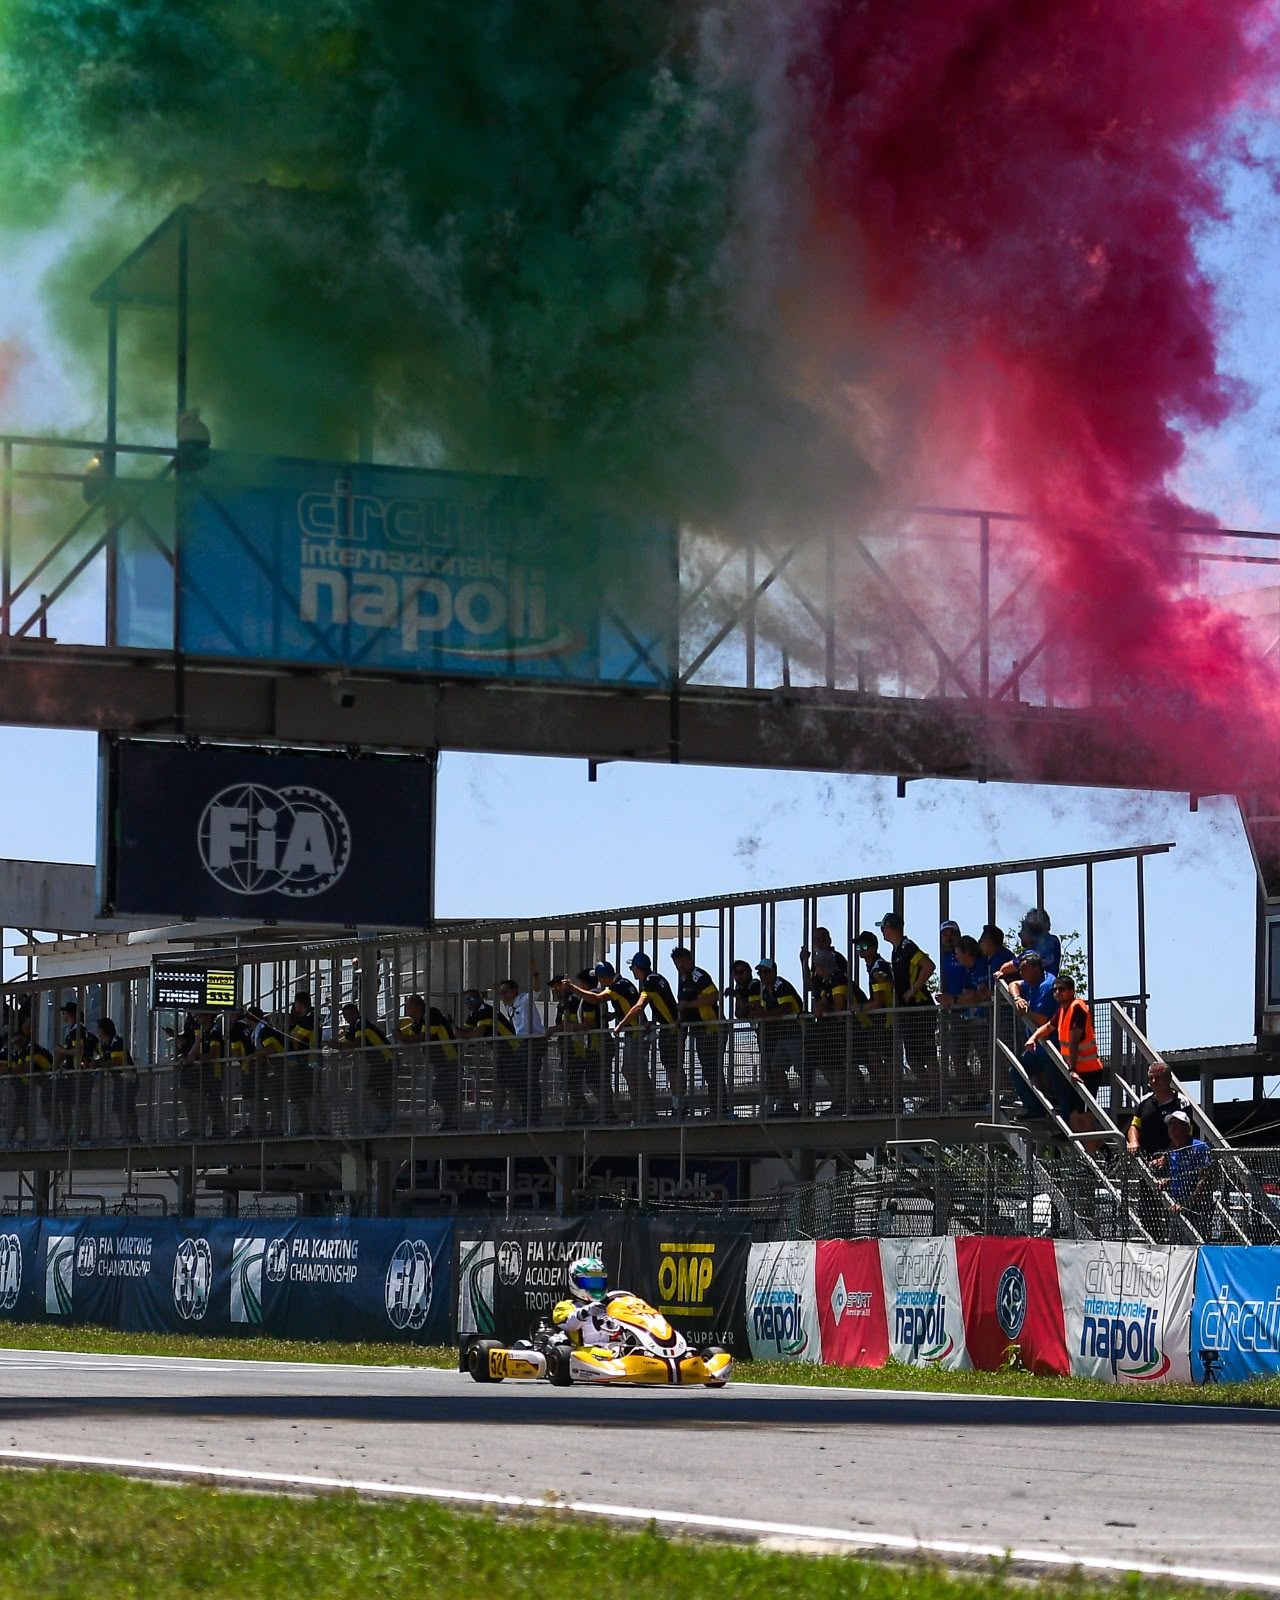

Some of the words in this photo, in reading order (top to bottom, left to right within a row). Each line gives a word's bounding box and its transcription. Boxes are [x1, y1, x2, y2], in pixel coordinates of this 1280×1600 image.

[301, 536, 507, 577] internazionale
[299, 564, 546, 652] napoli
[158, 989, 199, 1003] FINISH
[99, 1237, 114, 1254] FIA
[116, 1237, 152, 1255] KARTING
[292, 1239, 309, 1258] FIA
[312, 1239, 358, 1259] KARTING
[527, 1241, 544, 1261] FIA
[548, 1241, 602, 1261] KARTING
[290, 1263, 357, 1283] CHAMPIONSHIP
[525, 1267, 567, 1286] ACADEM
[895, 1243, 949, 1286] circuito
[1085, 1250, 1165, 1298] circuito
[658, 1255, 713, 1302] OMP
[846, 1291, 872, 1308] SPORT
[1084, 1294, 1146, 1319] internazionale
[753, 1293, 802, 1353] napoli
[895, 1294, 946, 1359] napoli
[1080, 1307, 1158, 1375] napoli
[490, 1351, 508, 1377] 524
